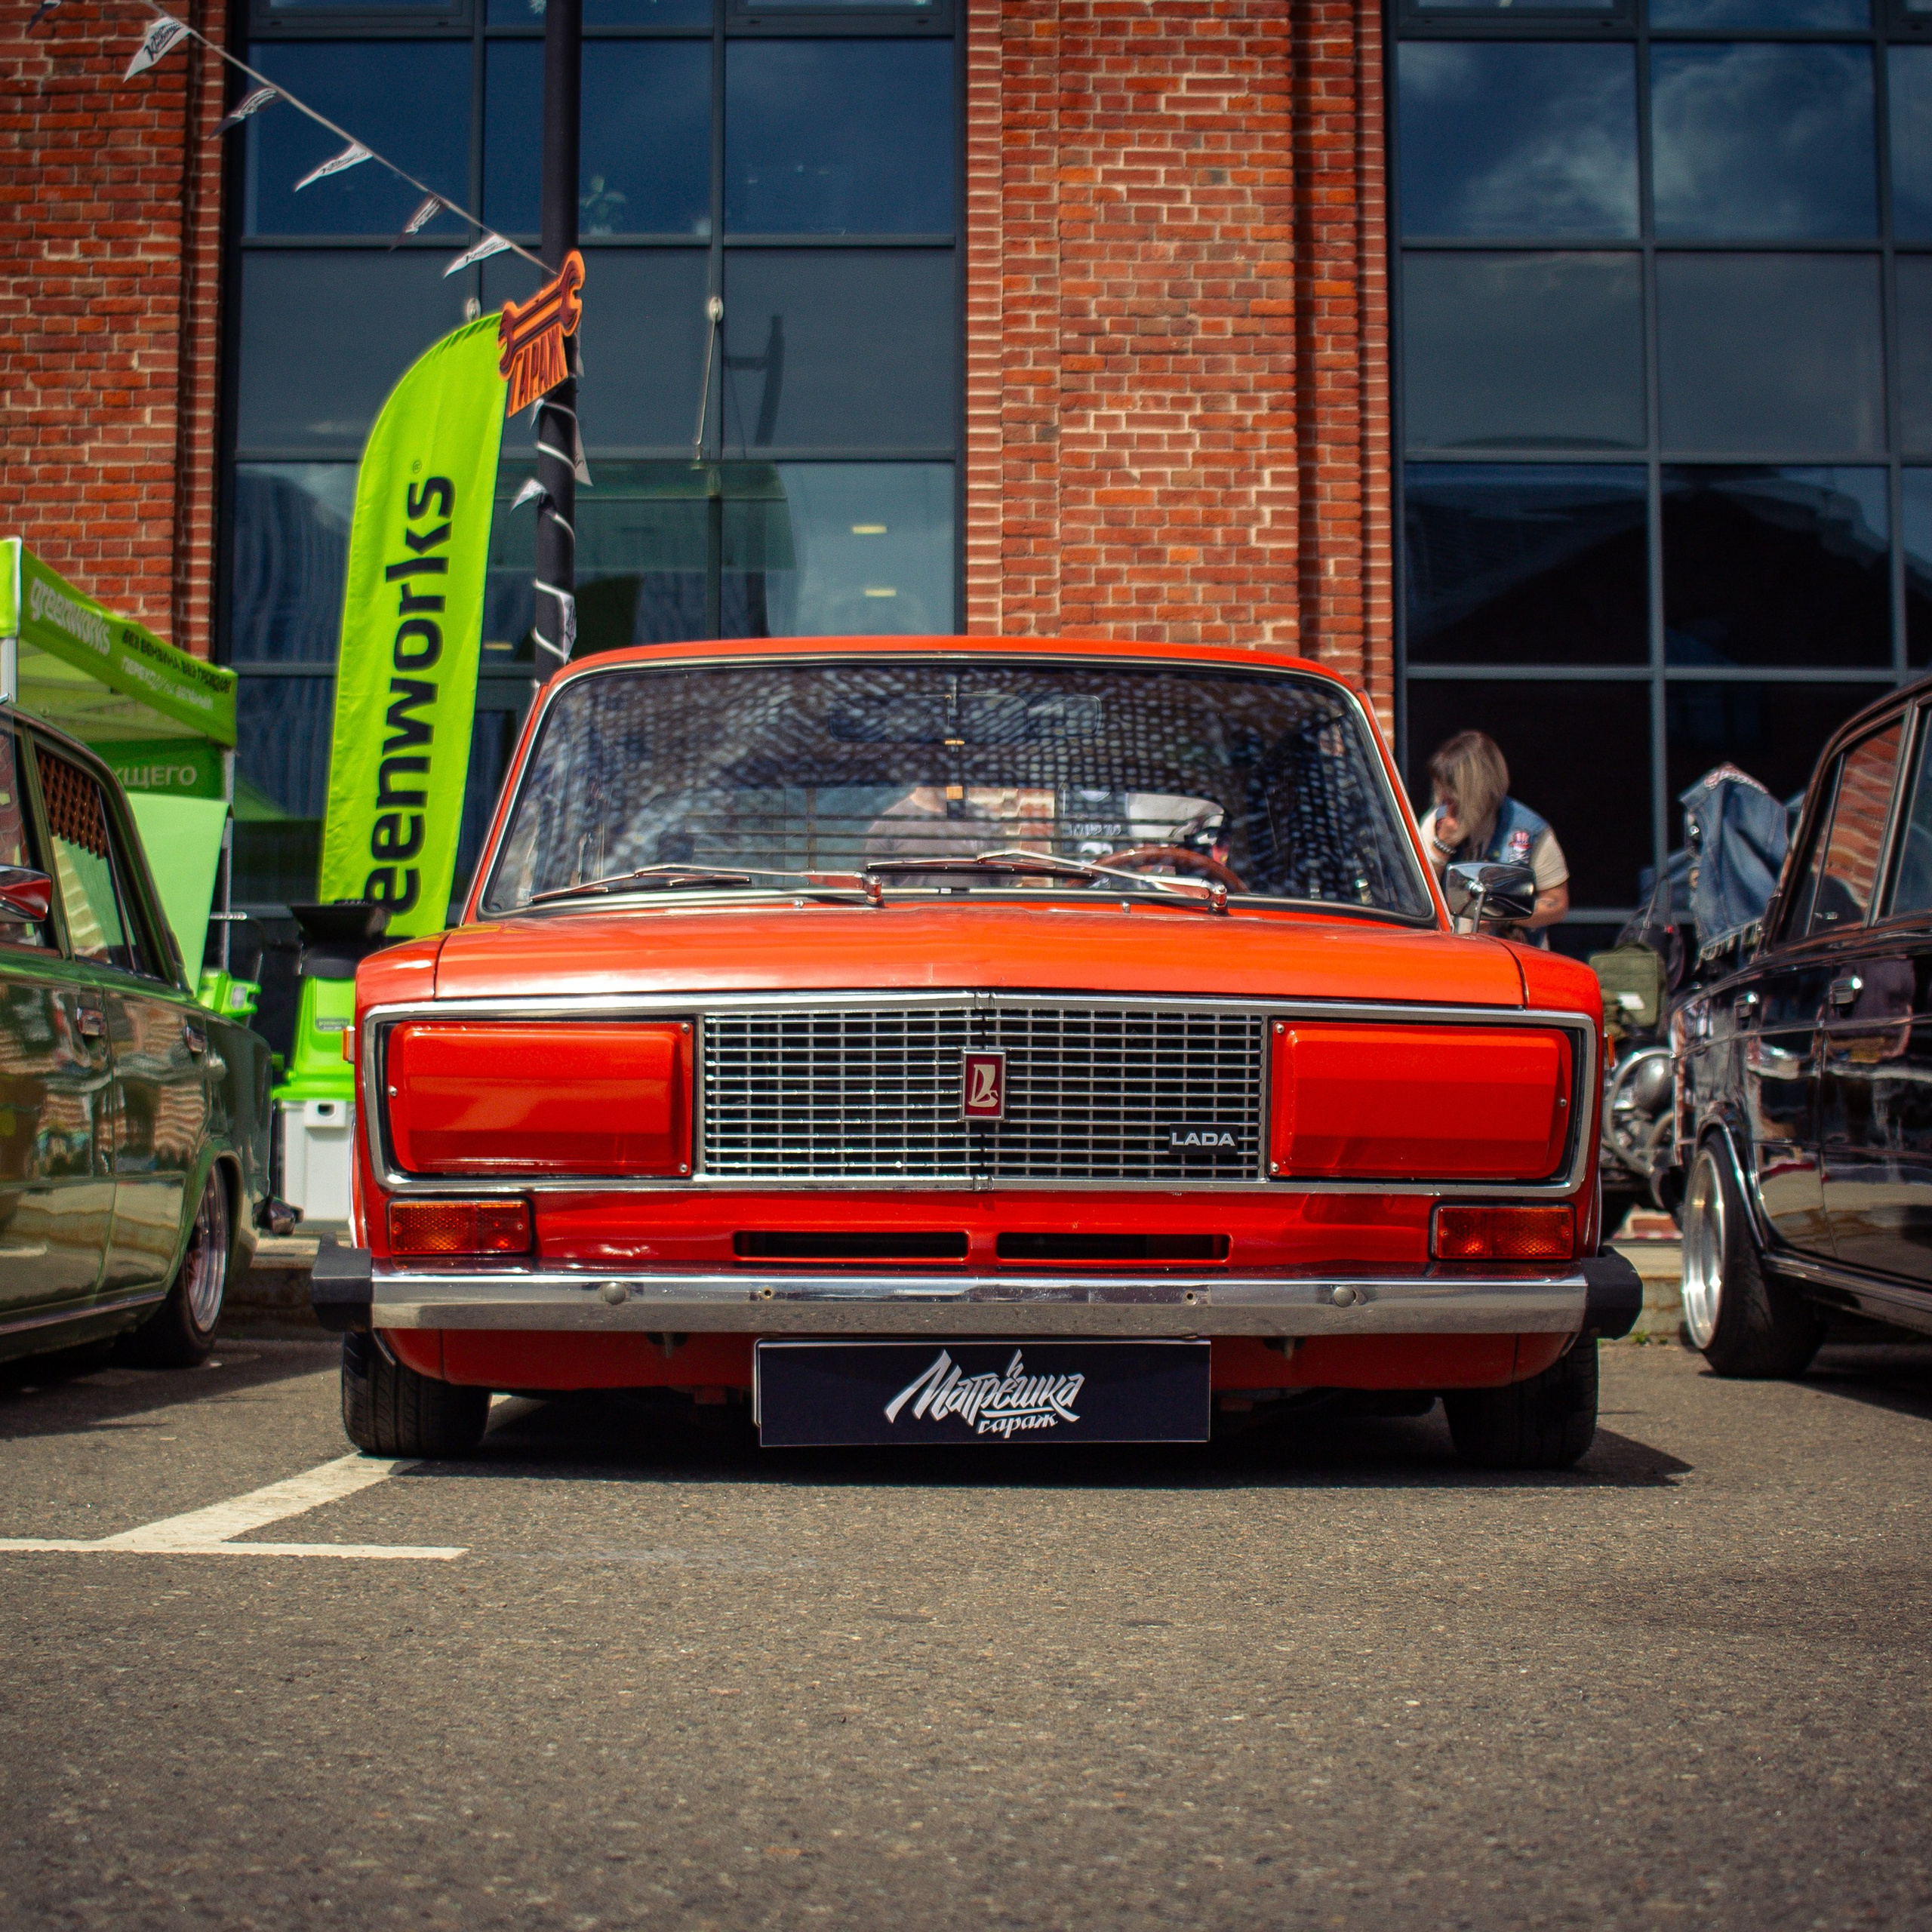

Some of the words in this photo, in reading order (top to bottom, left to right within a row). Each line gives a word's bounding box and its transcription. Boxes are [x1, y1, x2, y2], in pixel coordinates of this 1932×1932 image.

[509, 324, 565, 413] ГАРАЖ
[30, 577, 111, 657] greenworks
[360, 476, 456, 940] eenworks
[1171, 1132, 1236, 1146] LADA
[977, 1412, 1059, 1439] гараж
